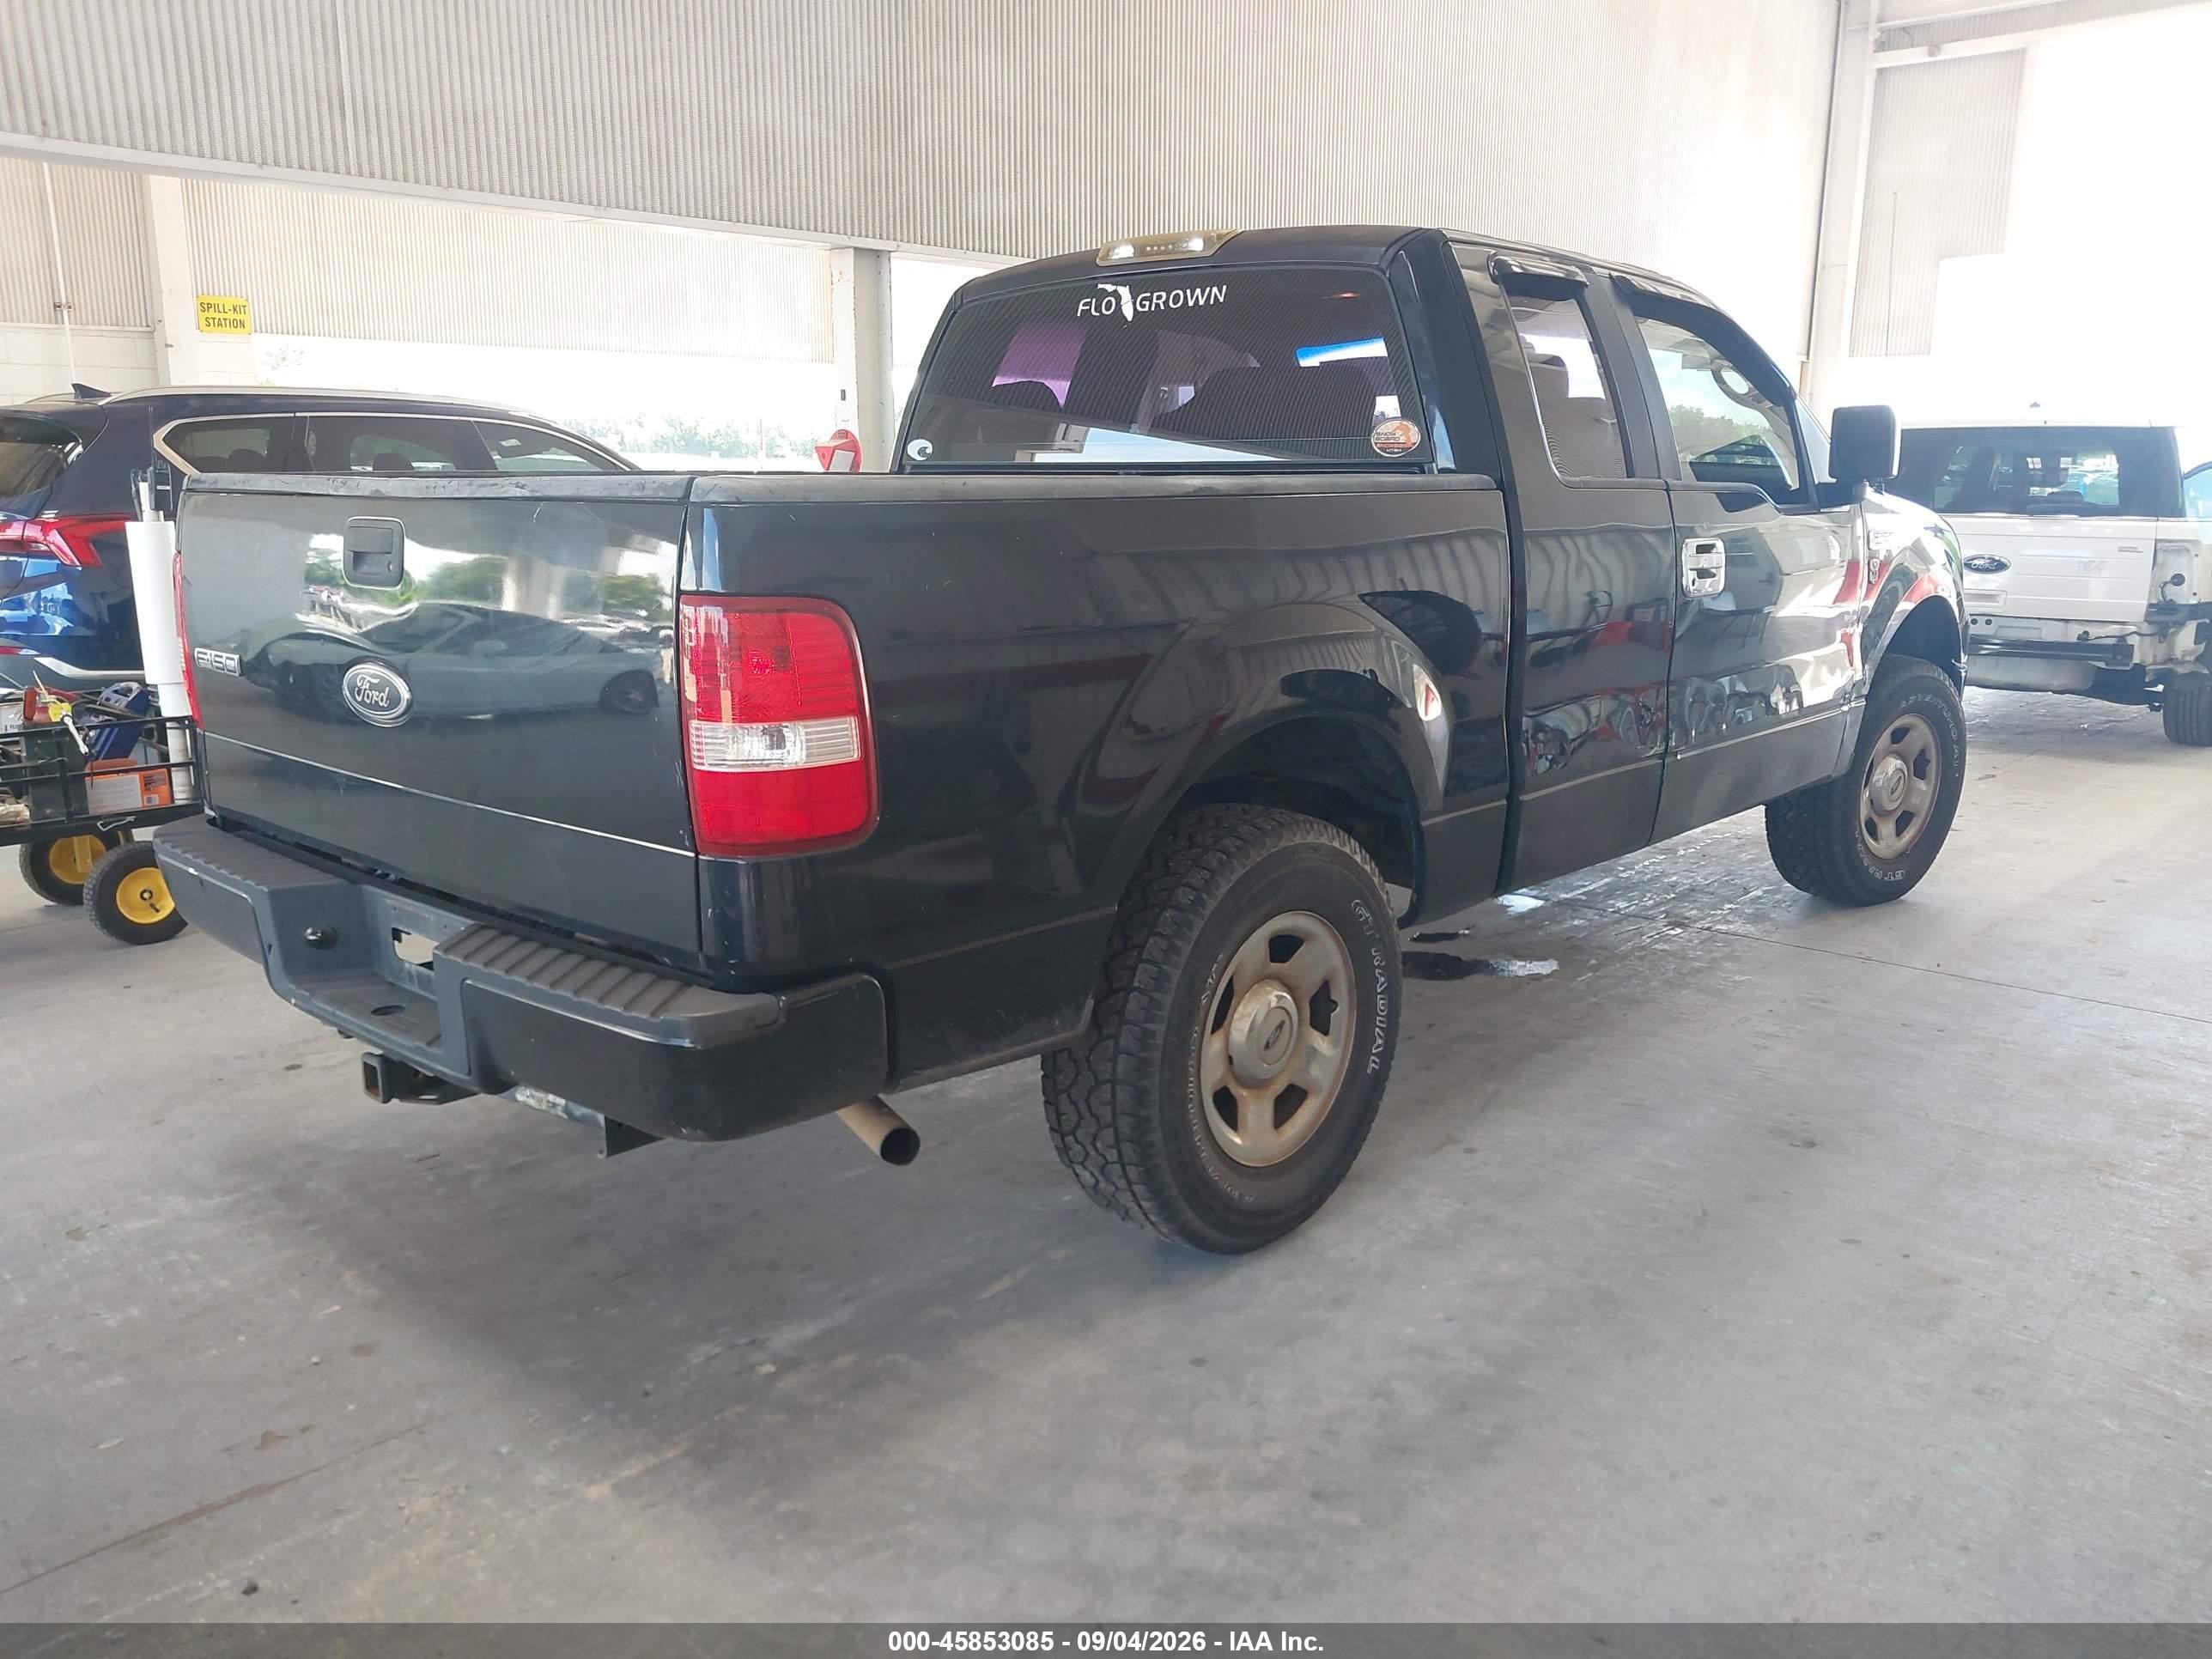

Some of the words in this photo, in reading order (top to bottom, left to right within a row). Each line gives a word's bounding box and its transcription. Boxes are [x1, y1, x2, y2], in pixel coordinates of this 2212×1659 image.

[199, 301, 247, 315] SPILL-KIT
[1077, 296, 1116, 317] FLO
[1135, 284, 1228, 312] GROWN
[204, 316, 246, 329] STATION
[354, 674, 390, 708] Ford
[1367, 945, 1389, 1074] RADIAL
